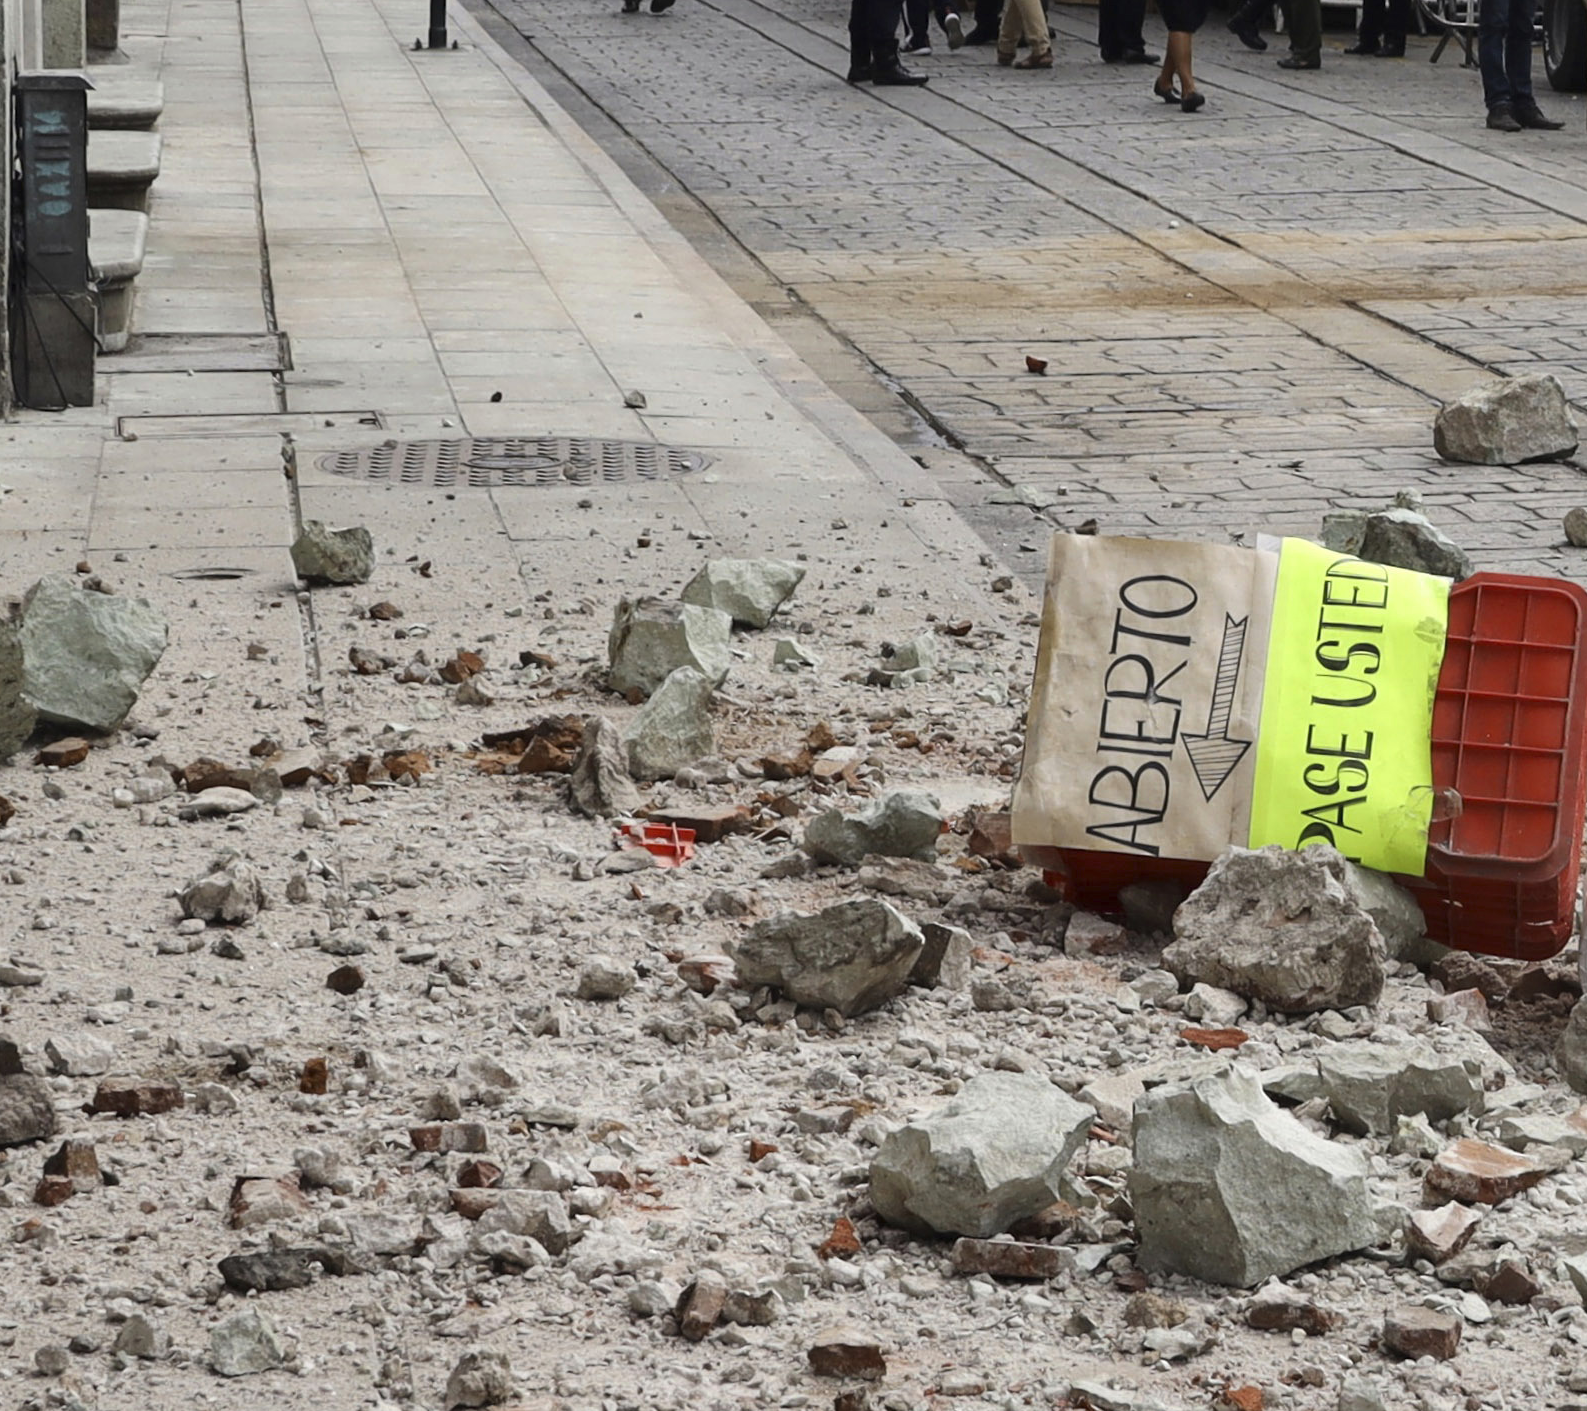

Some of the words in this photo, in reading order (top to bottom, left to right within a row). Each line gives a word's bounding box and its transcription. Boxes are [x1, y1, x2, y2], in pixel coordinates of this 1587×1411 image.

[1311, 558, 1390, 708] USTED
[1086, 575, 1198, 857] ABIERTO
[1296, 724, 1374, 862] PASE
